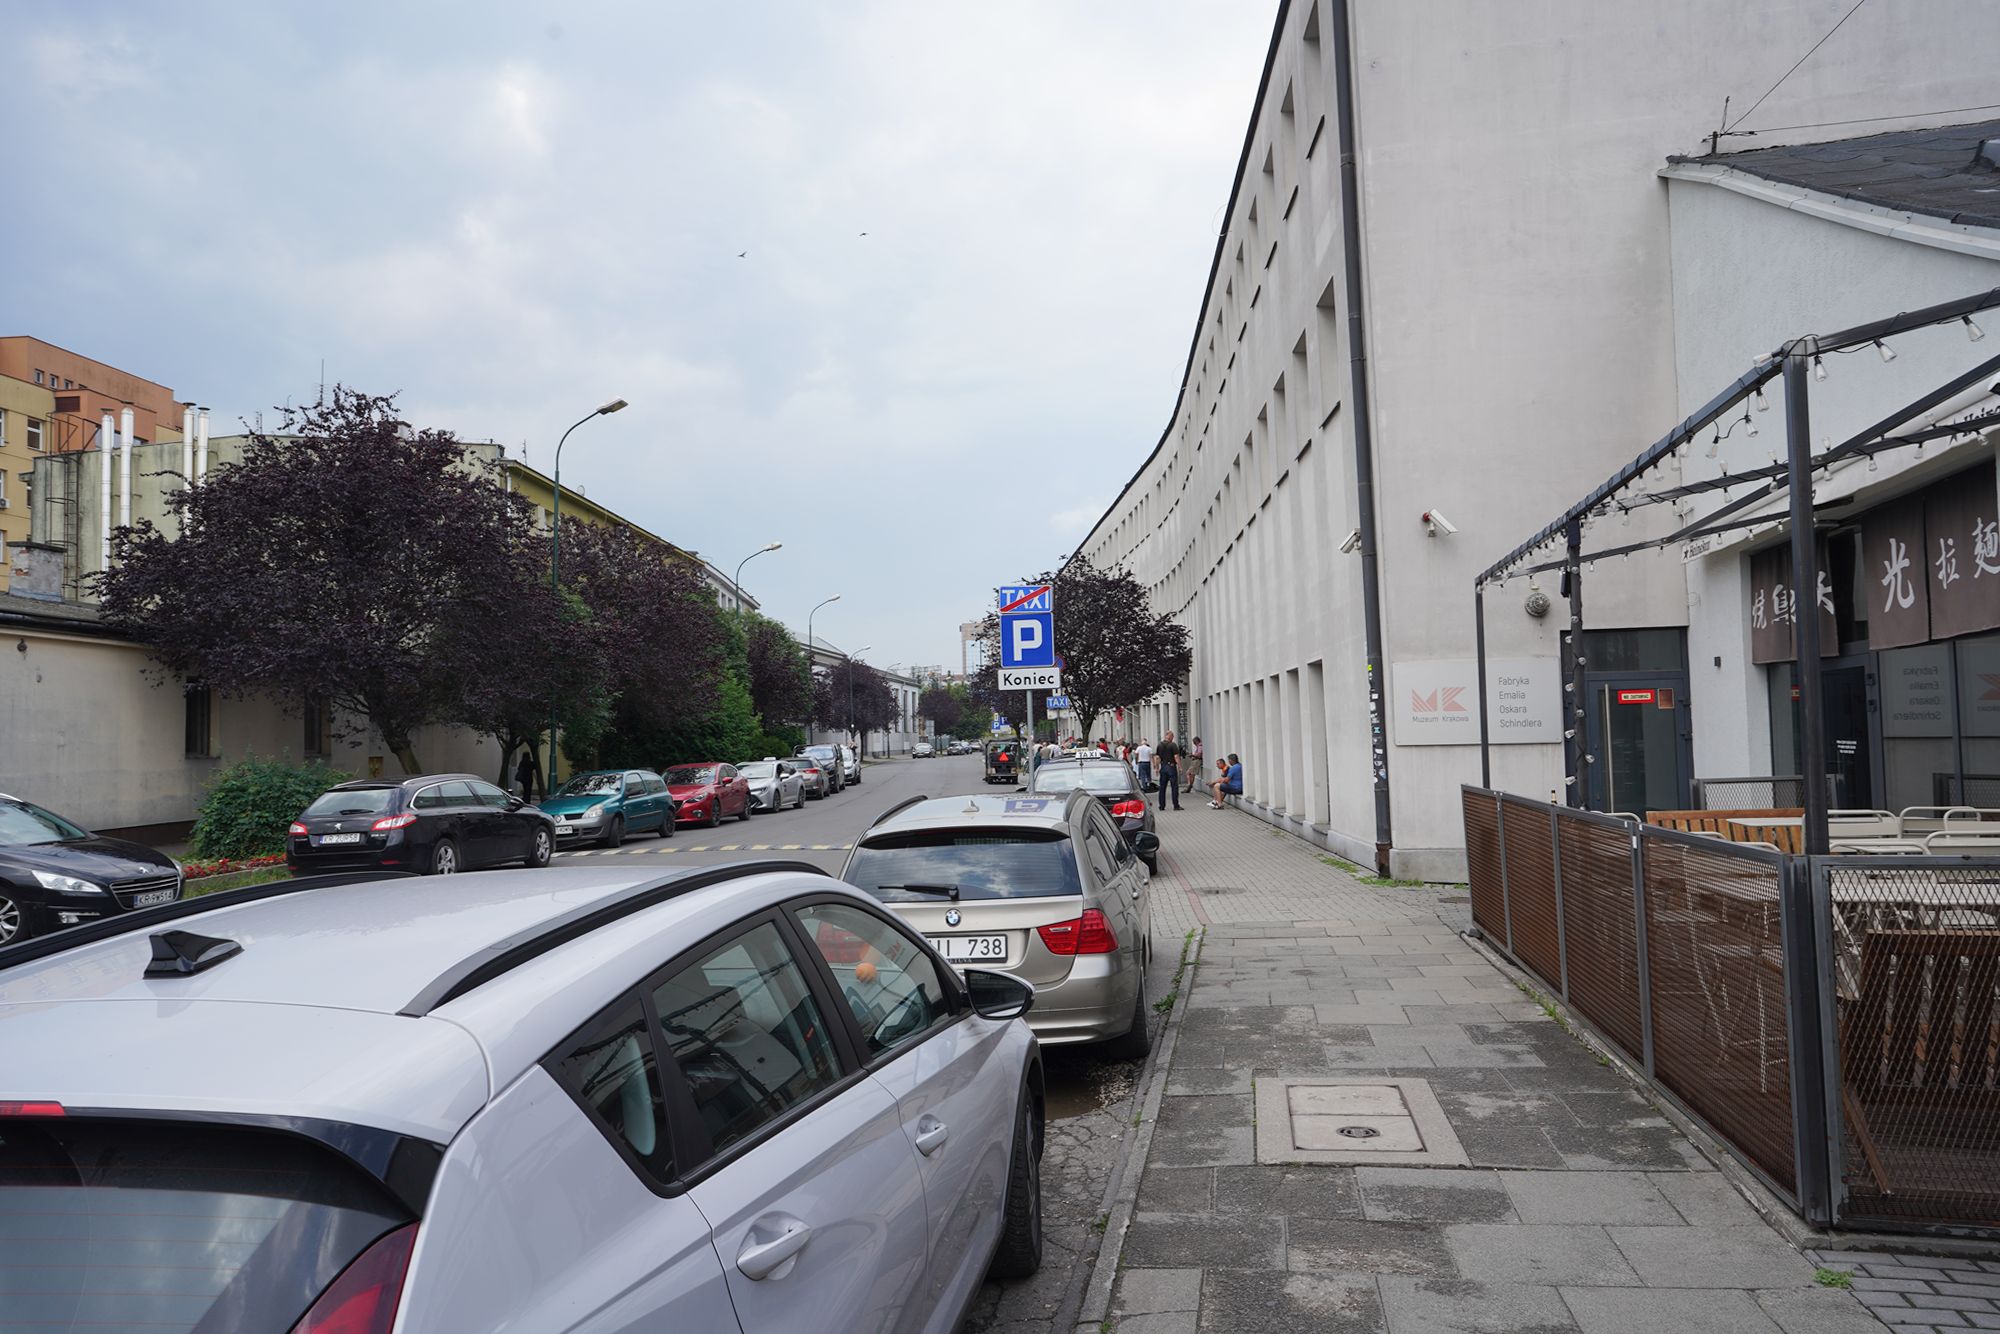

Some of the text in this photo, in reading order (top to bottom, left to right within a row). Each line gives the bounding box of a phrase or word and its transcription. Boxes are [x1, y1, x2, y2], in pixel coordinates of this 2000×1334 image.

[1002, 589, 1049, 609] TAXI
[1013, 619, 1042, 661] P
[1003, 673, 1055, 686] Koniec
[1498, 677, 1530, 687] Fabryka
[1499, 691, 1526, 700] Emalia
[1048, 697, 1068, 708] TAXI
[1499, 705, 1528, 714] Oskara
[1500, 719, 1543, 728] Schindlera
[968, 938, 1002, 956] 738
